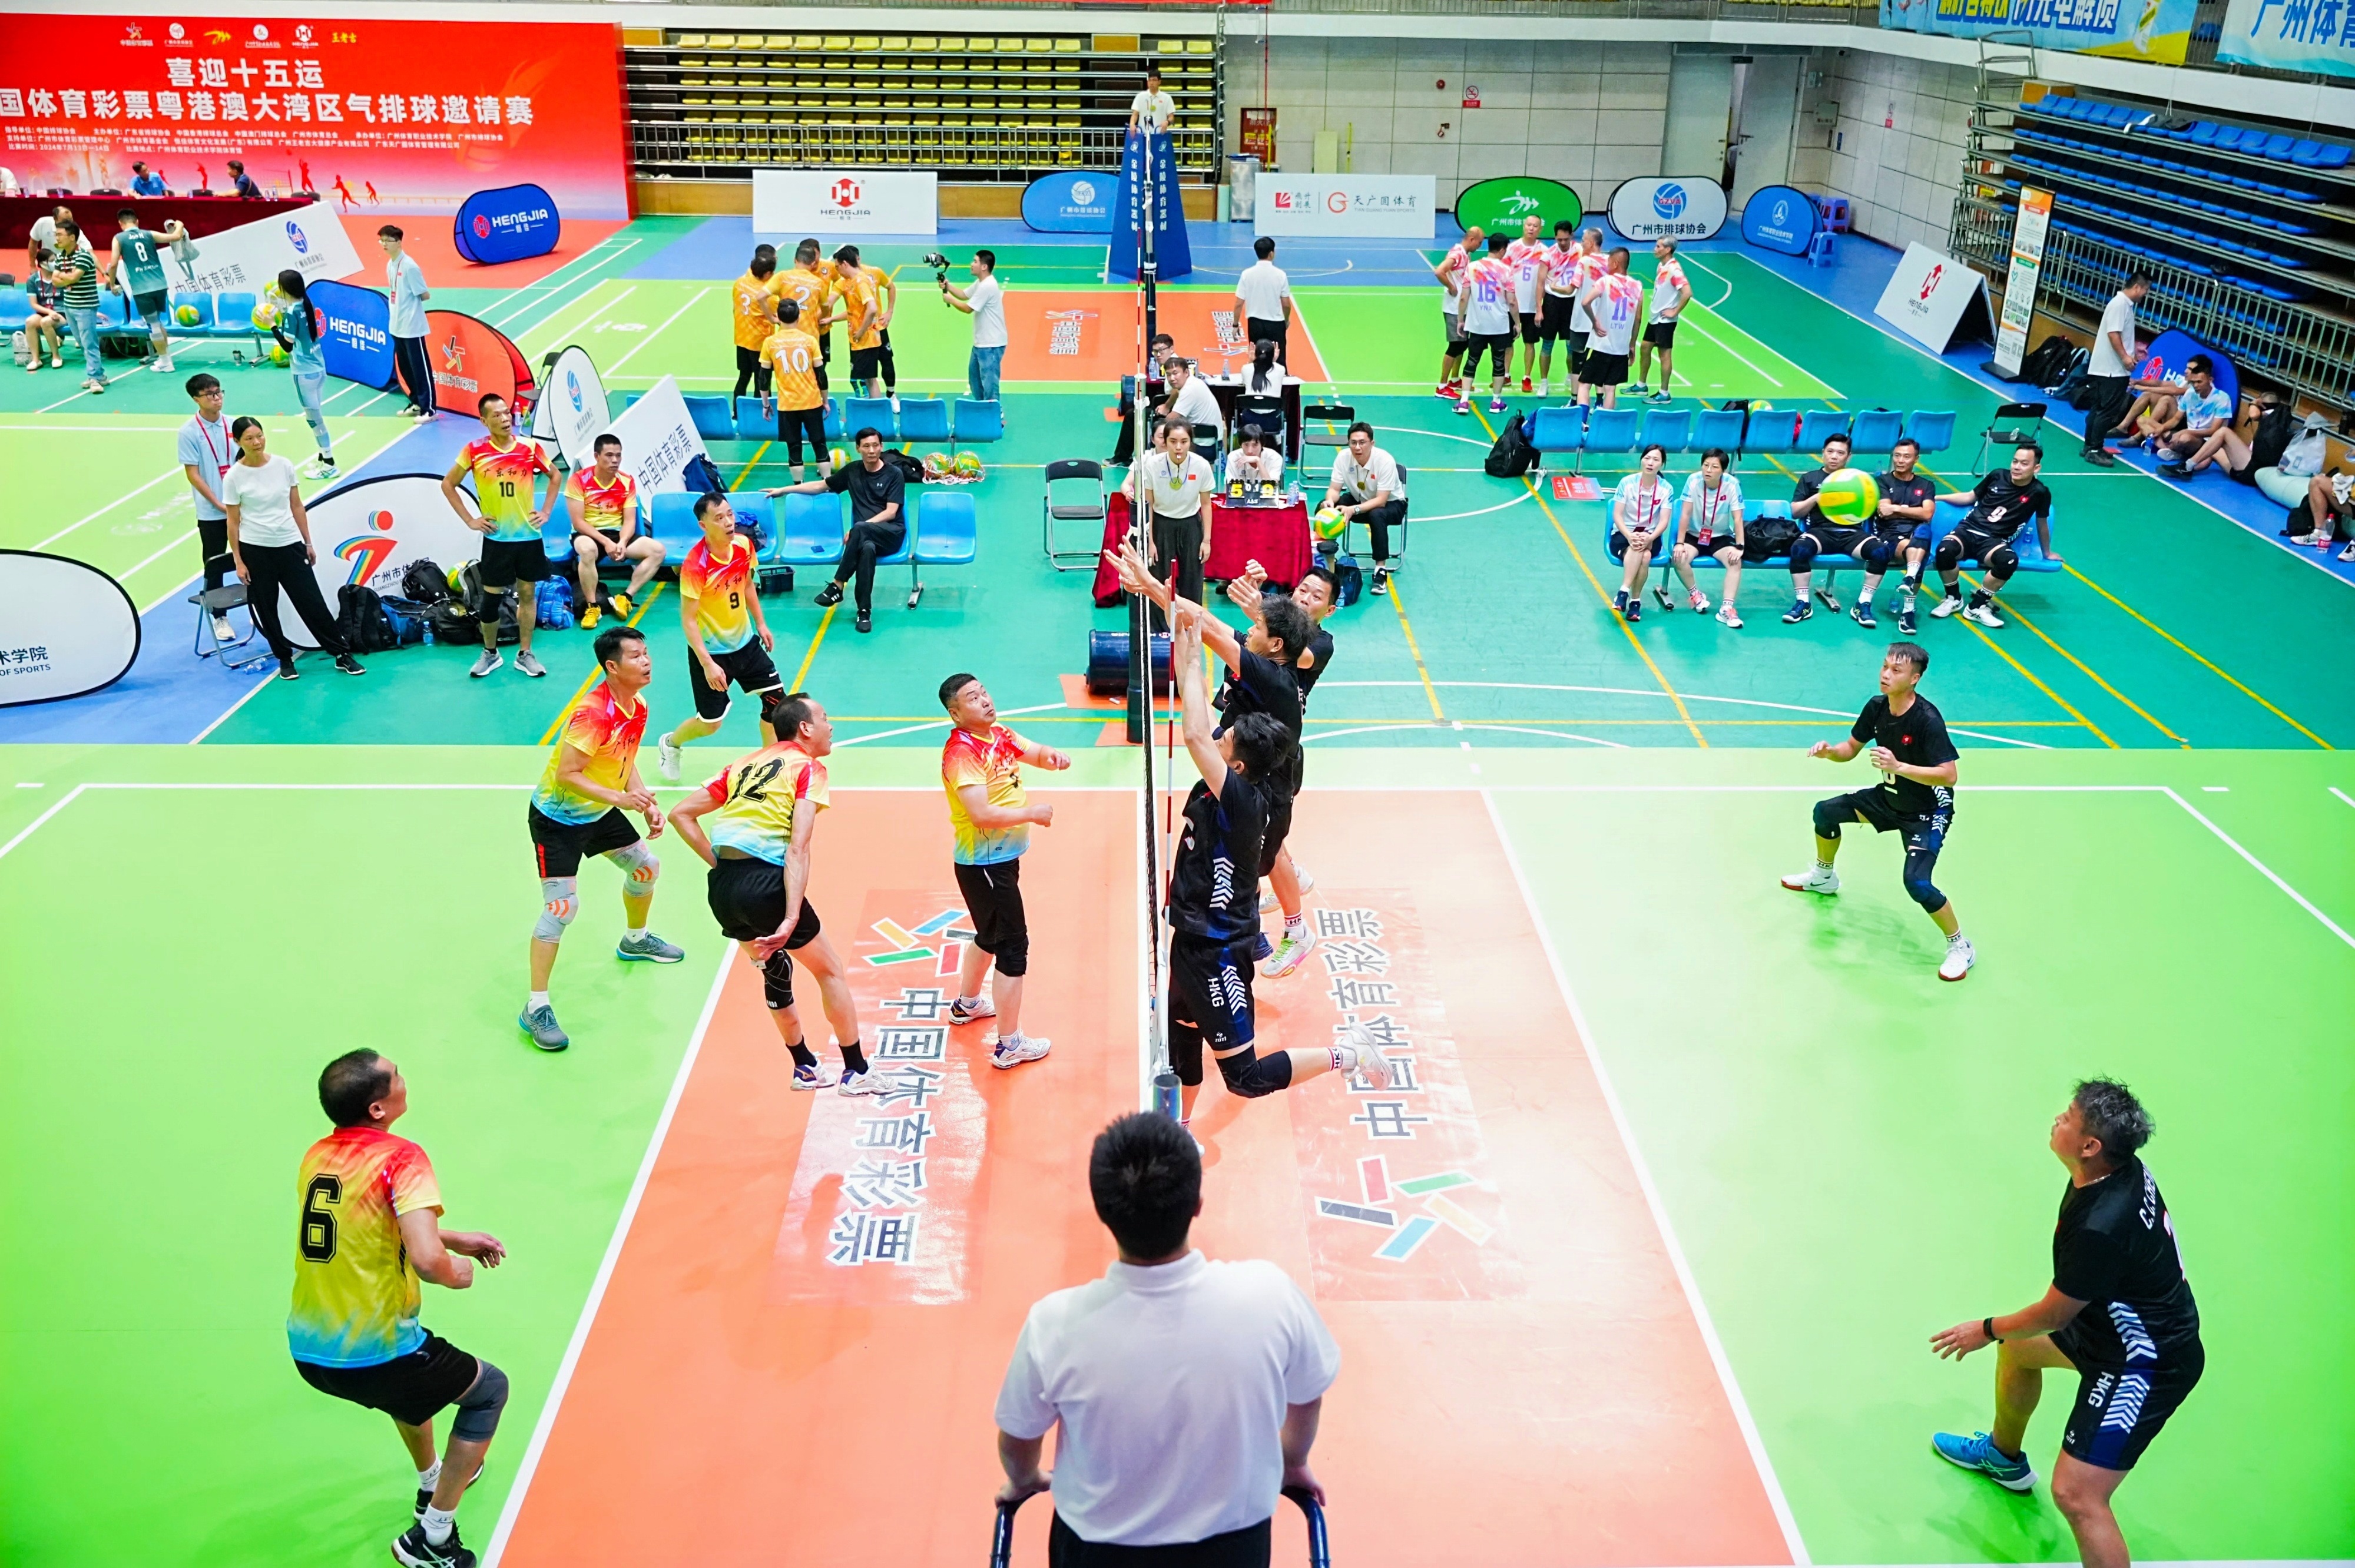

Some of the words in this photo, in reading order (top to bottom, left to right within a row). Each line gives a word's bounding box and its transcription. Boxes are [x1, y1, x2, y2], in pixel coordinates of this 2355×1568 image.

[165, 57, 324, 88] 喜迎十五运
[0, 88, 534, 125] 国体育彩票粤港澳大湾区气排球邀请赛
[492, 209, 548, 227] HENGJIA
[1632, 223, 1706, 235] 广州市排球协会
[135, 242, 148, 262] 8
[1522, 267, 1531, 281] 6
[795, 286, 812, 310] 2
[1477, 280, 1496, 303] 16
[740, 293, 751, 315] 3
[1612, 297, 1627, 321] 11
[330, 316, 386, 346] HENGJIA
[775, 347, 809, 374] 10
[432, 370, 478, 393] 中国体育彩票
[638, 423, 692, 495] 中国体育彩票
[499, 482, 515, 498] 10
[1230, 484, 1243, 497] 5
[1261, 484, 1274, 496] 9
[1987, 506, 2007, 523] 9
[372, 557, 429, 586] 广州市体
[730, 592, 740, 609] 9
[0, 646, 48, 665] 术学院
[14, 664, 51, 675] SPORTS
[726, 757, 785, 805] 12
[1208, 977, 1224, 1007] HKG
[826, 988, 953, 1265] 中国体育彩票
[299, 1172, 342, 1264] 6
[2088, 1371, 2115, 1407] HKG
